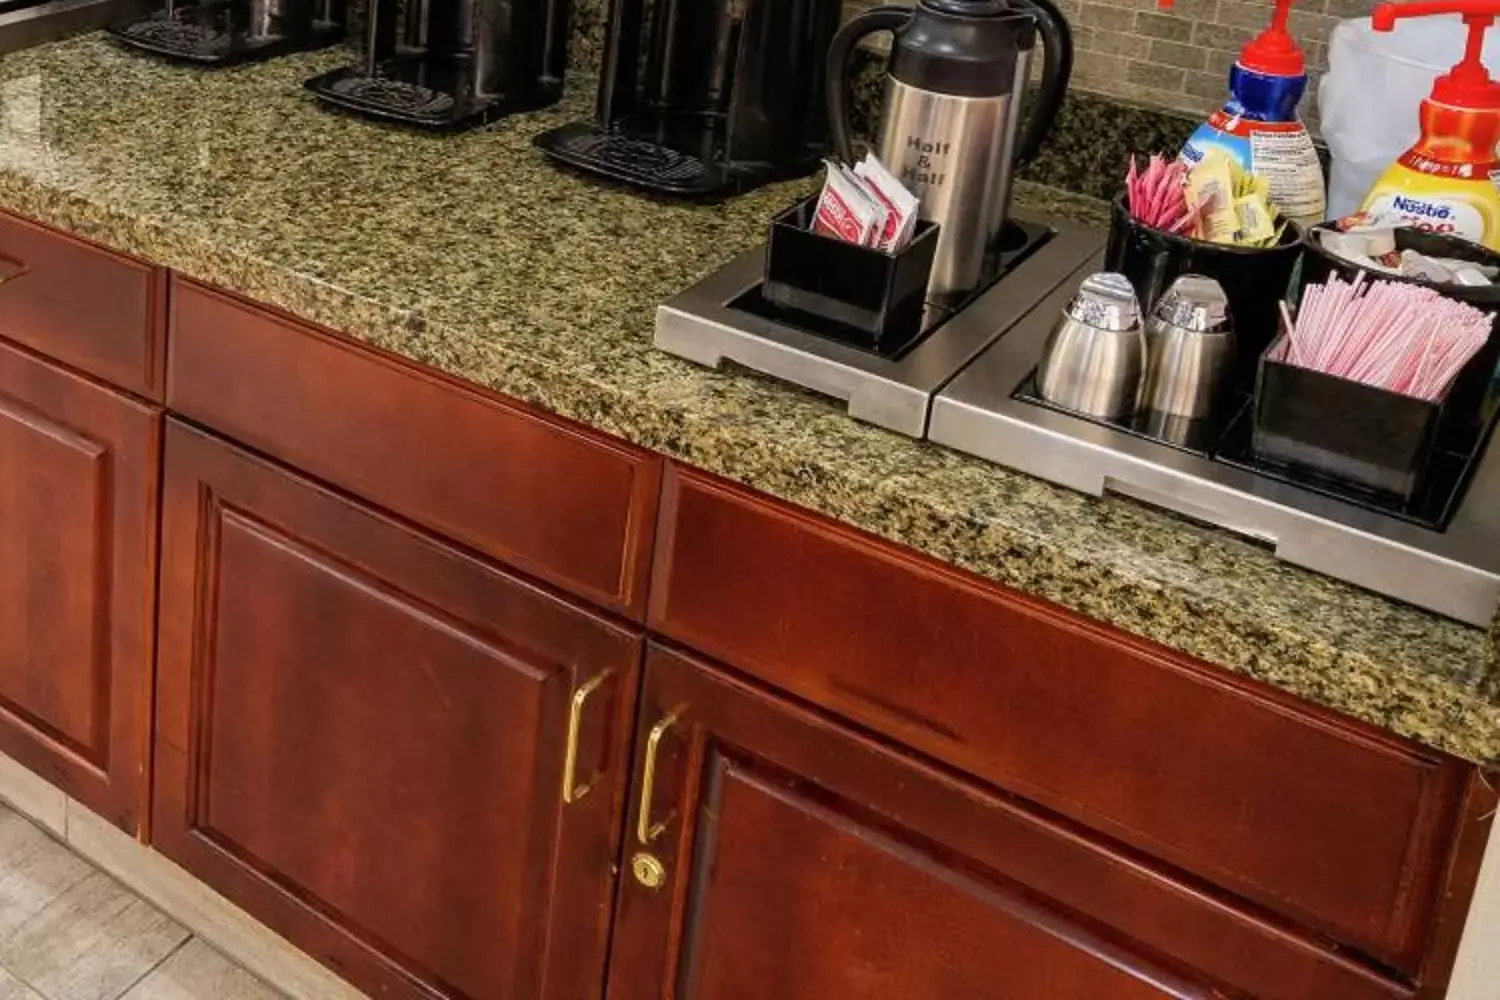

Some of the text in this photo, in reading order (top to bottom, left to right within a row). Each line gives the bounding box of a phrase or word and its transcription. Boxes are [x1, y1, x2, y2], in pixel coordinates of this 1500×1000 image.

[907, 135, 950, 155] Half
[917, 155, 930, 168] &
[902, 167, 946, 185] Half
